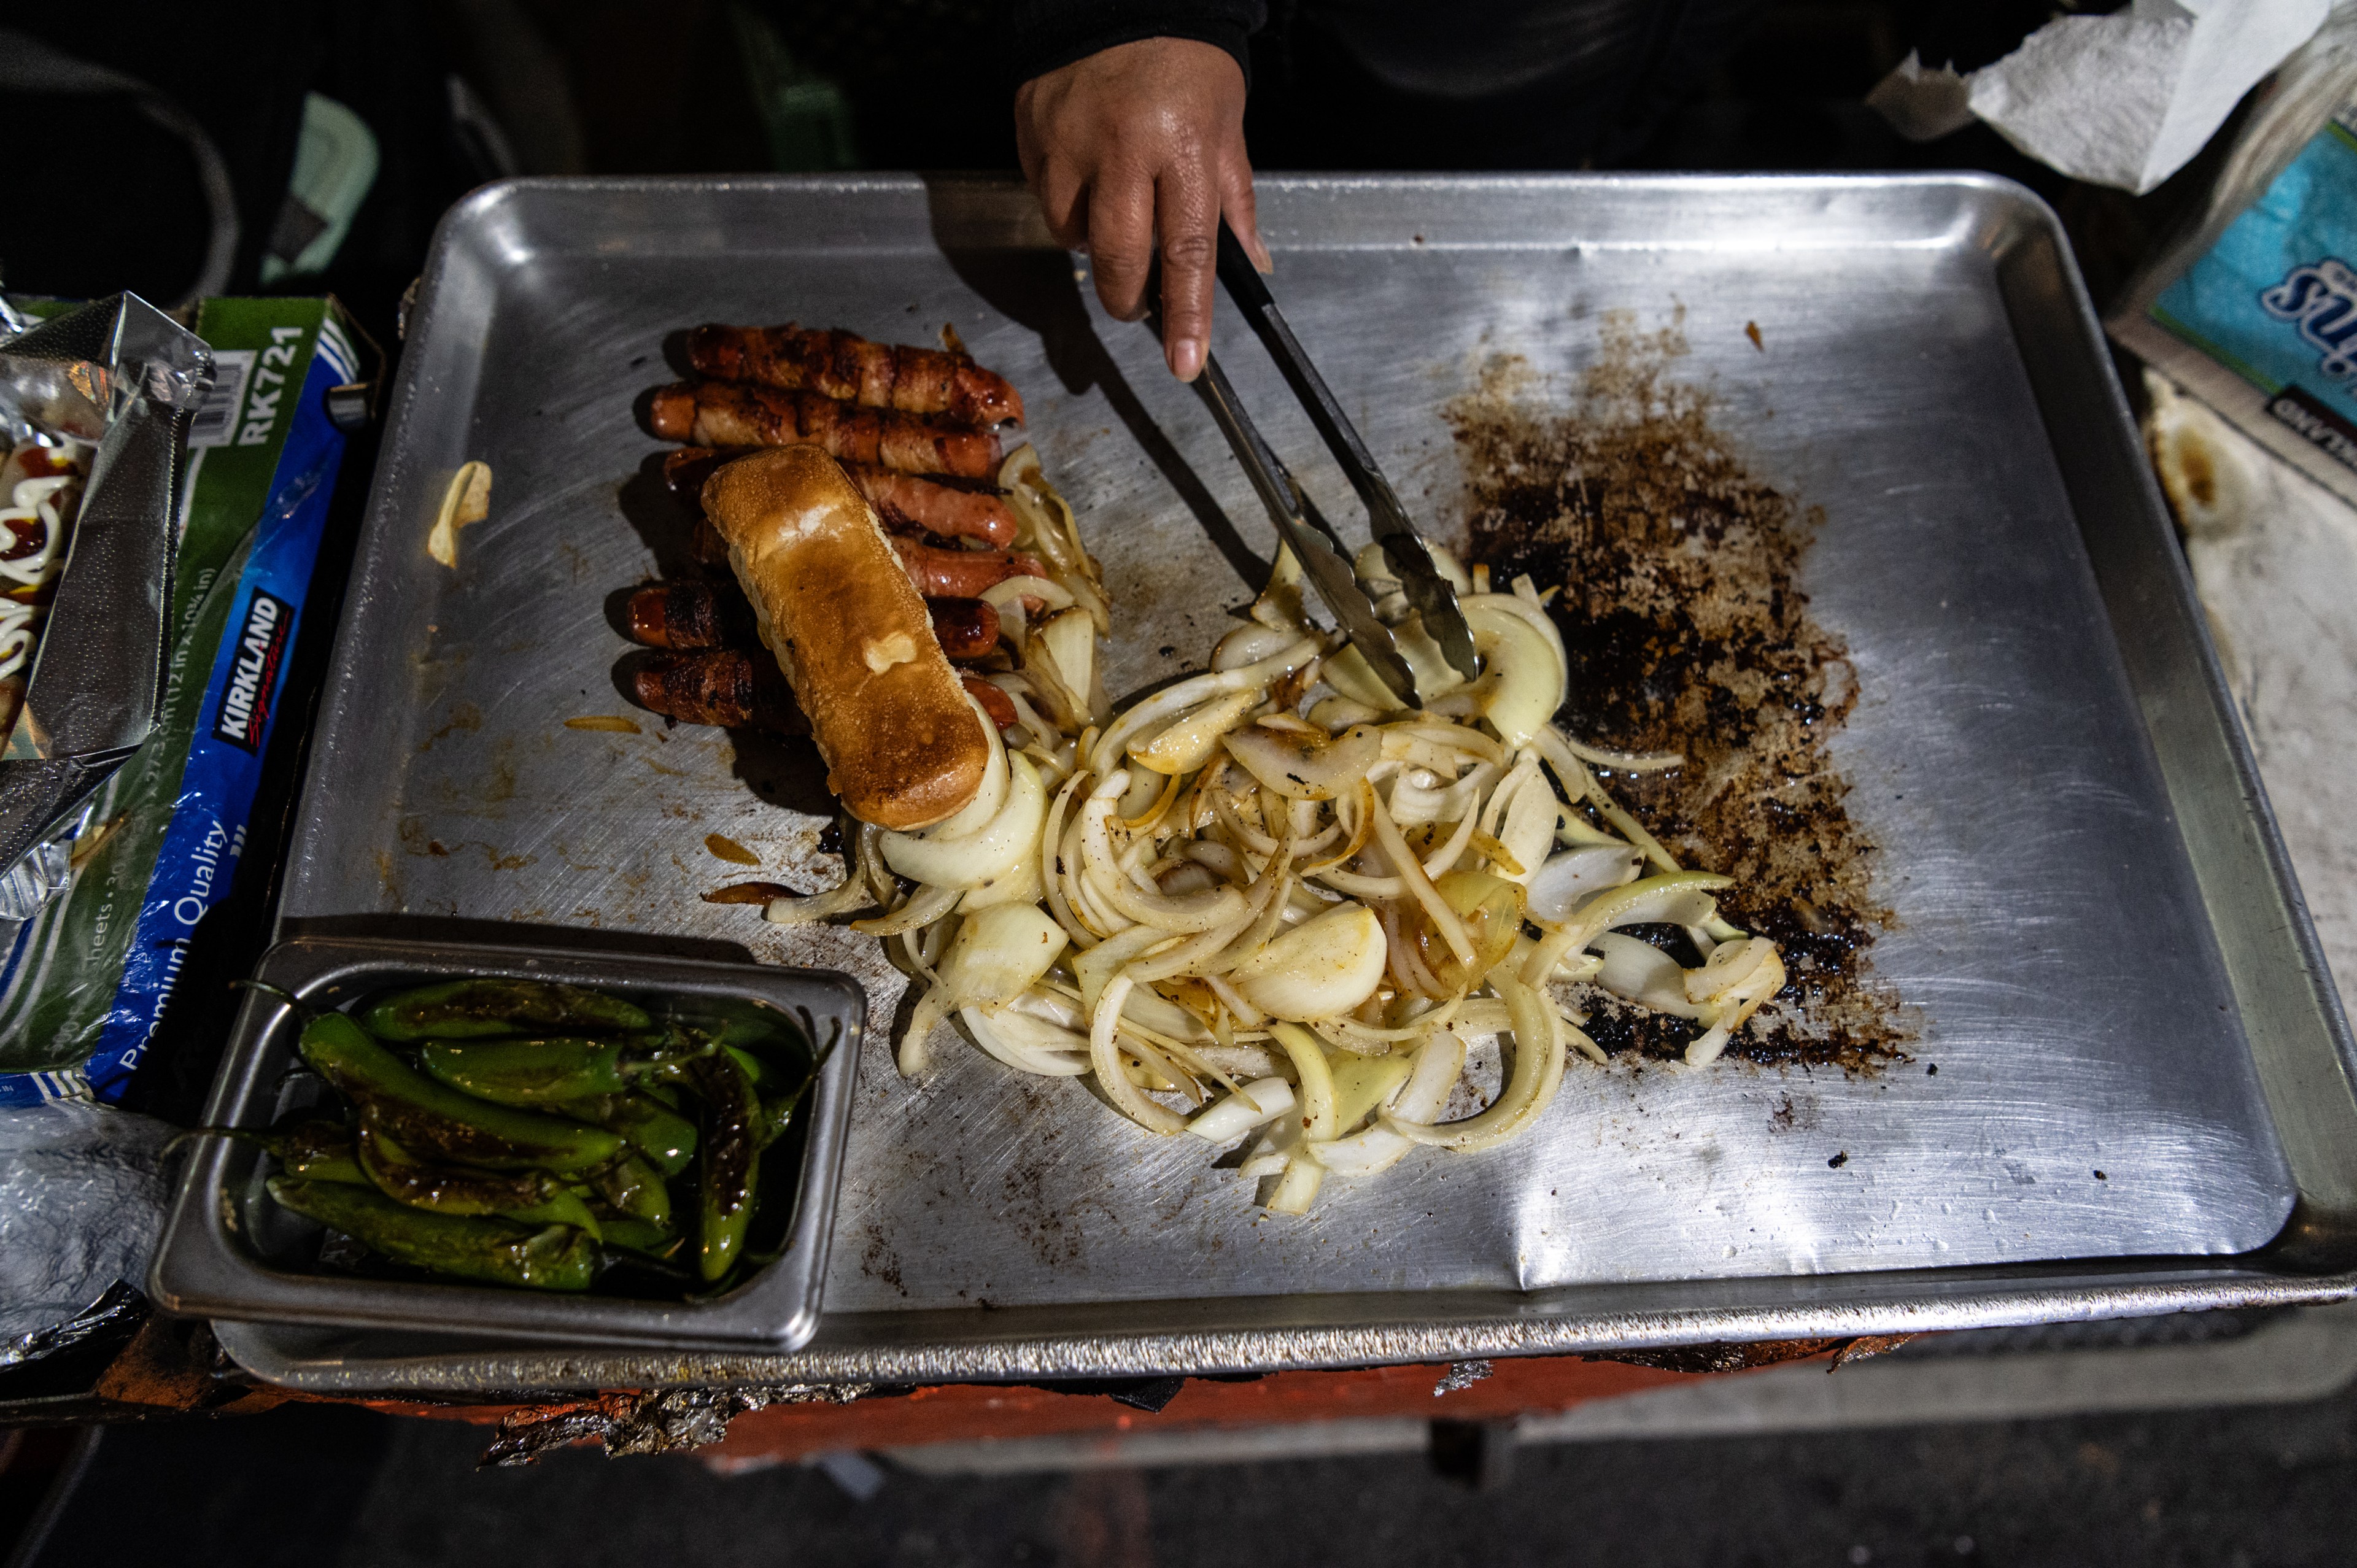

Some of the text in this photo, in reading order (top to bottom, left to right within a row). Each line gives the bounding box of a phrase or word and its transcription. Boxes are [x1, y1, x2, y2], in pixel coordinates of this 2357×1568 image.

[237, 326, 303, 447] RK721
[193, 568, 218, 591] in)
[170, 649, 188, 668] in
[181, 635, 193, 646] x
[165, 673, 184, 703] (12
[221, 597, 279, 740] KIRKLAND
[249, 609, 290, 748] Signature
[158, 708, 176, 736] cm
[84, 903, 113, 971] heets
[119, 937, 193, 1072] Premium
[174, 819, 228, 925] Quality
